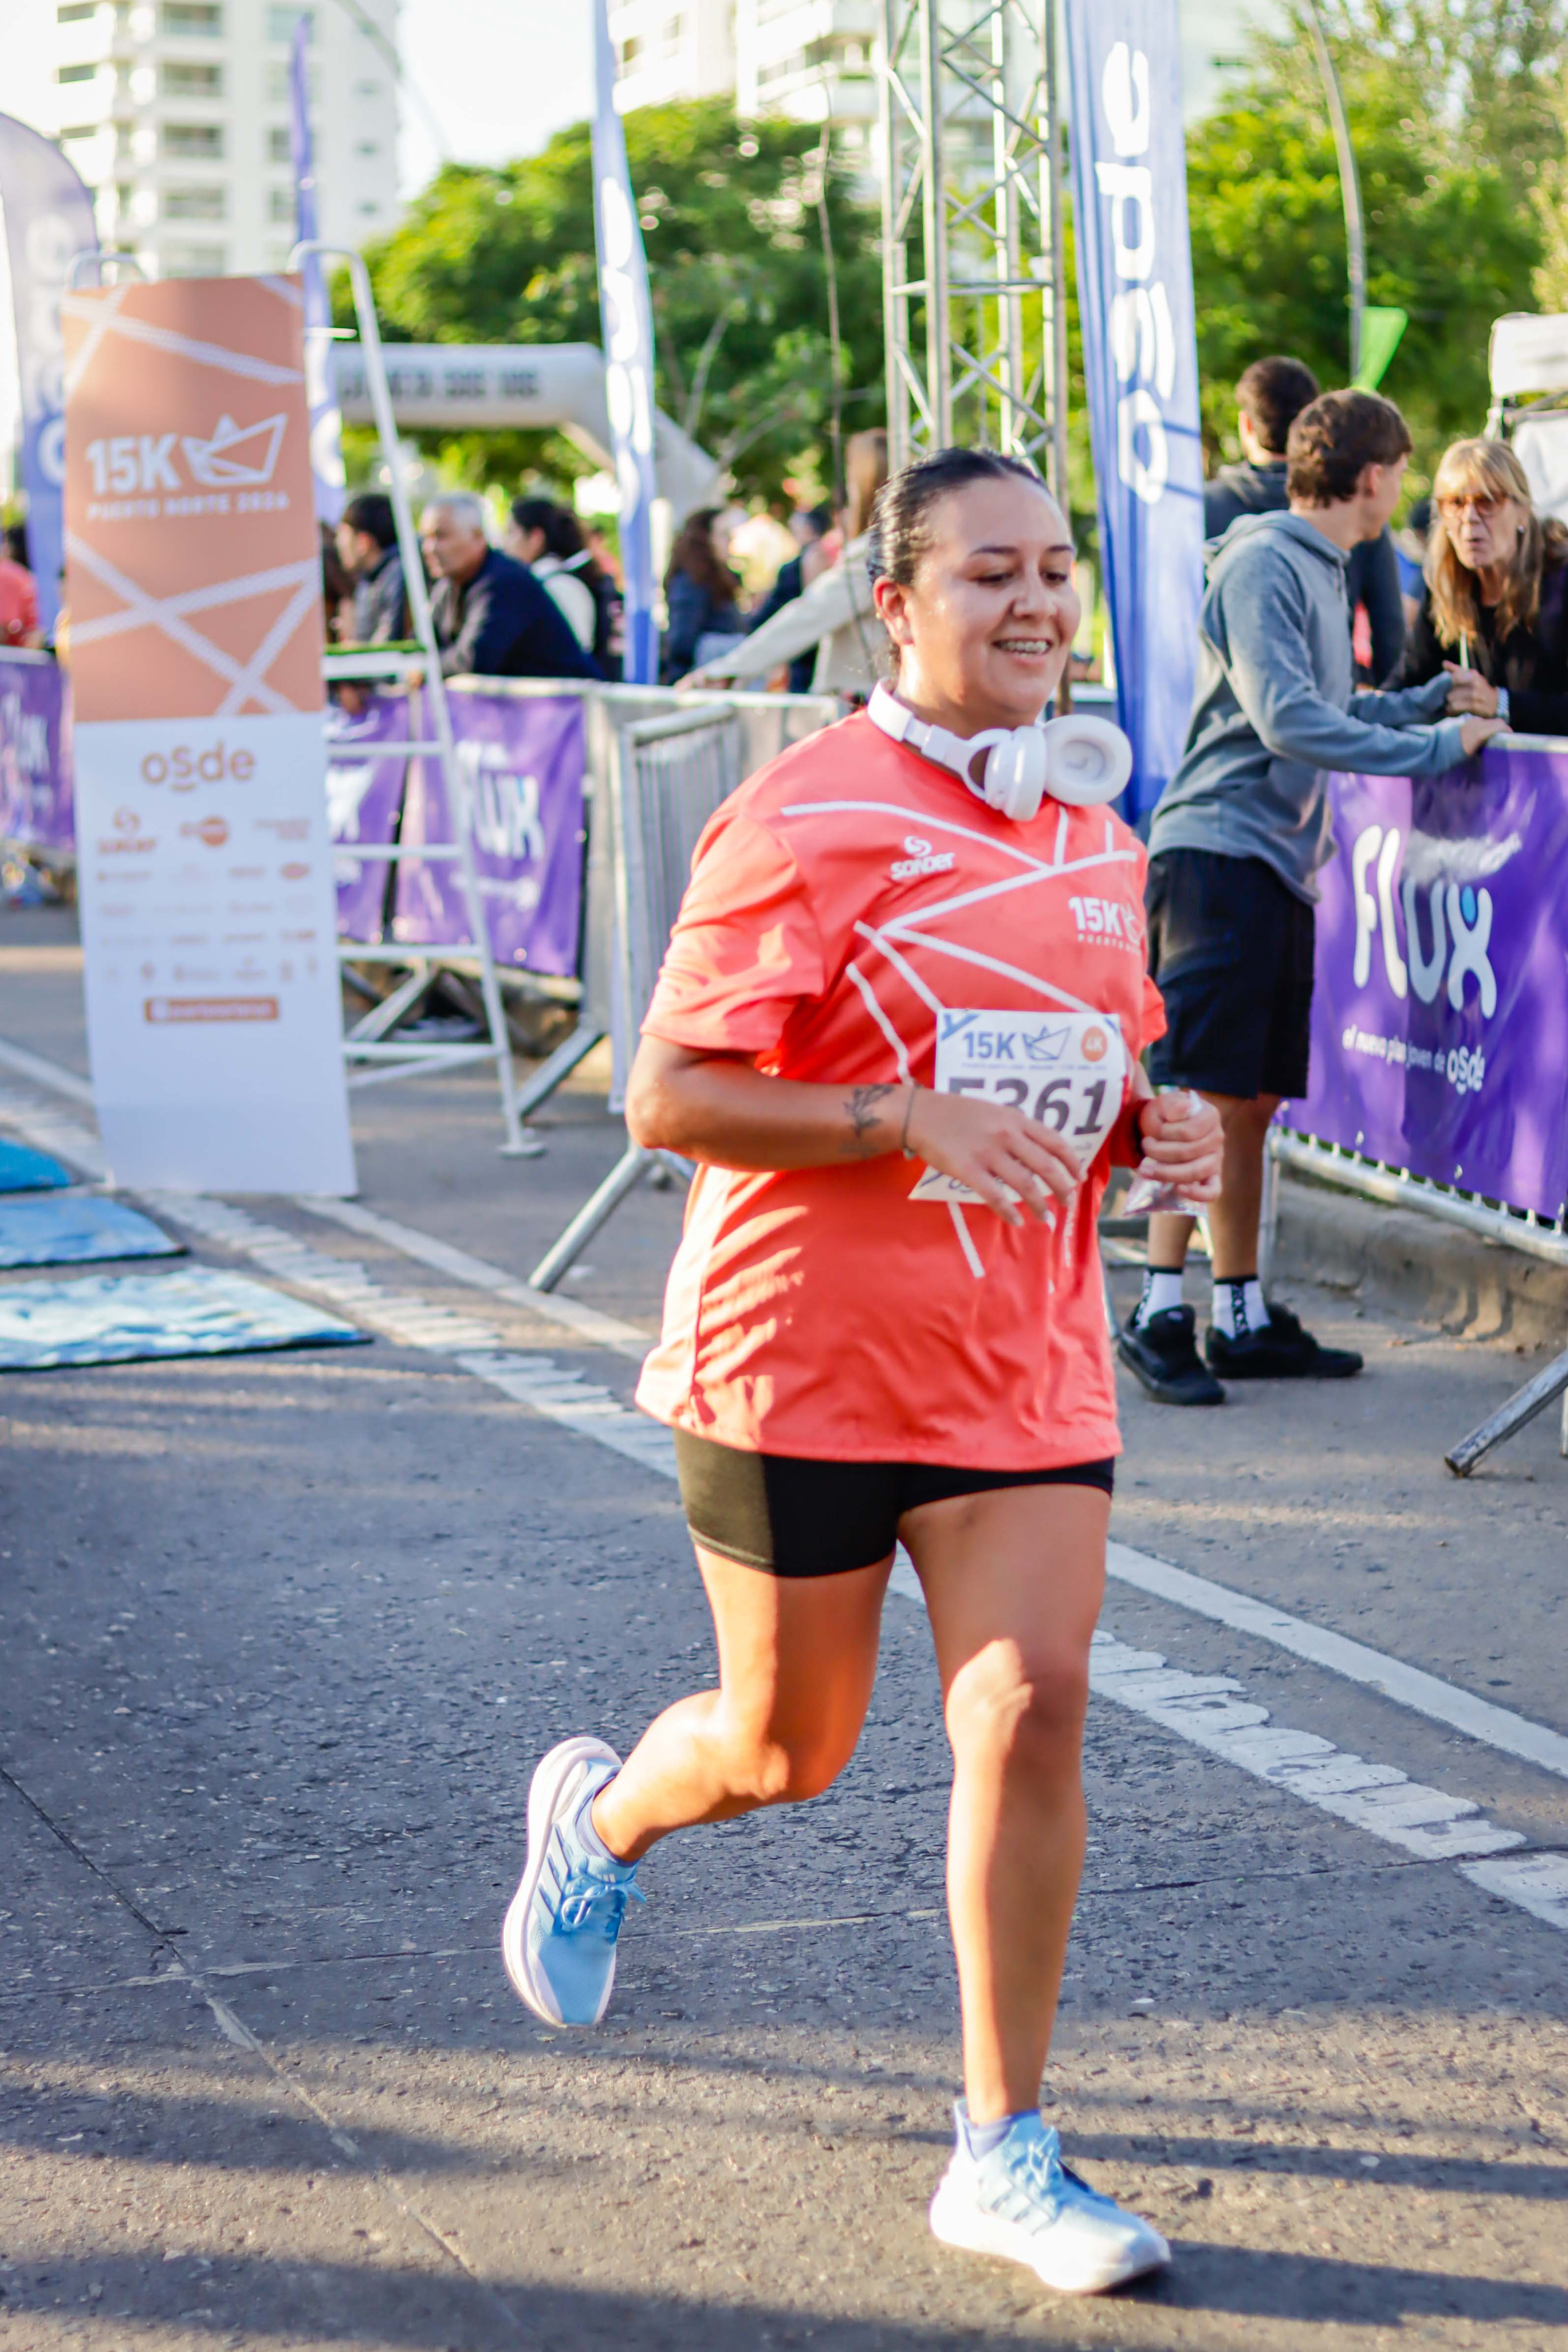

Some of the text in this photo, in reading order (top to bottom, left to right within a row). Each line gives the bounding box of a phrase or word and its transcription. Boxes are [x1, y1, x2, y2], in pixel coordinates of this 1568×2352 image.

[86, 432, 181, 496] 15K
[141, 739, 256, 791] osde
[1068, 896, 1123, 937] 15K
[963, 1031, 1015, 1059] 15K
[1447, 1044, 1485, 1094] osde
